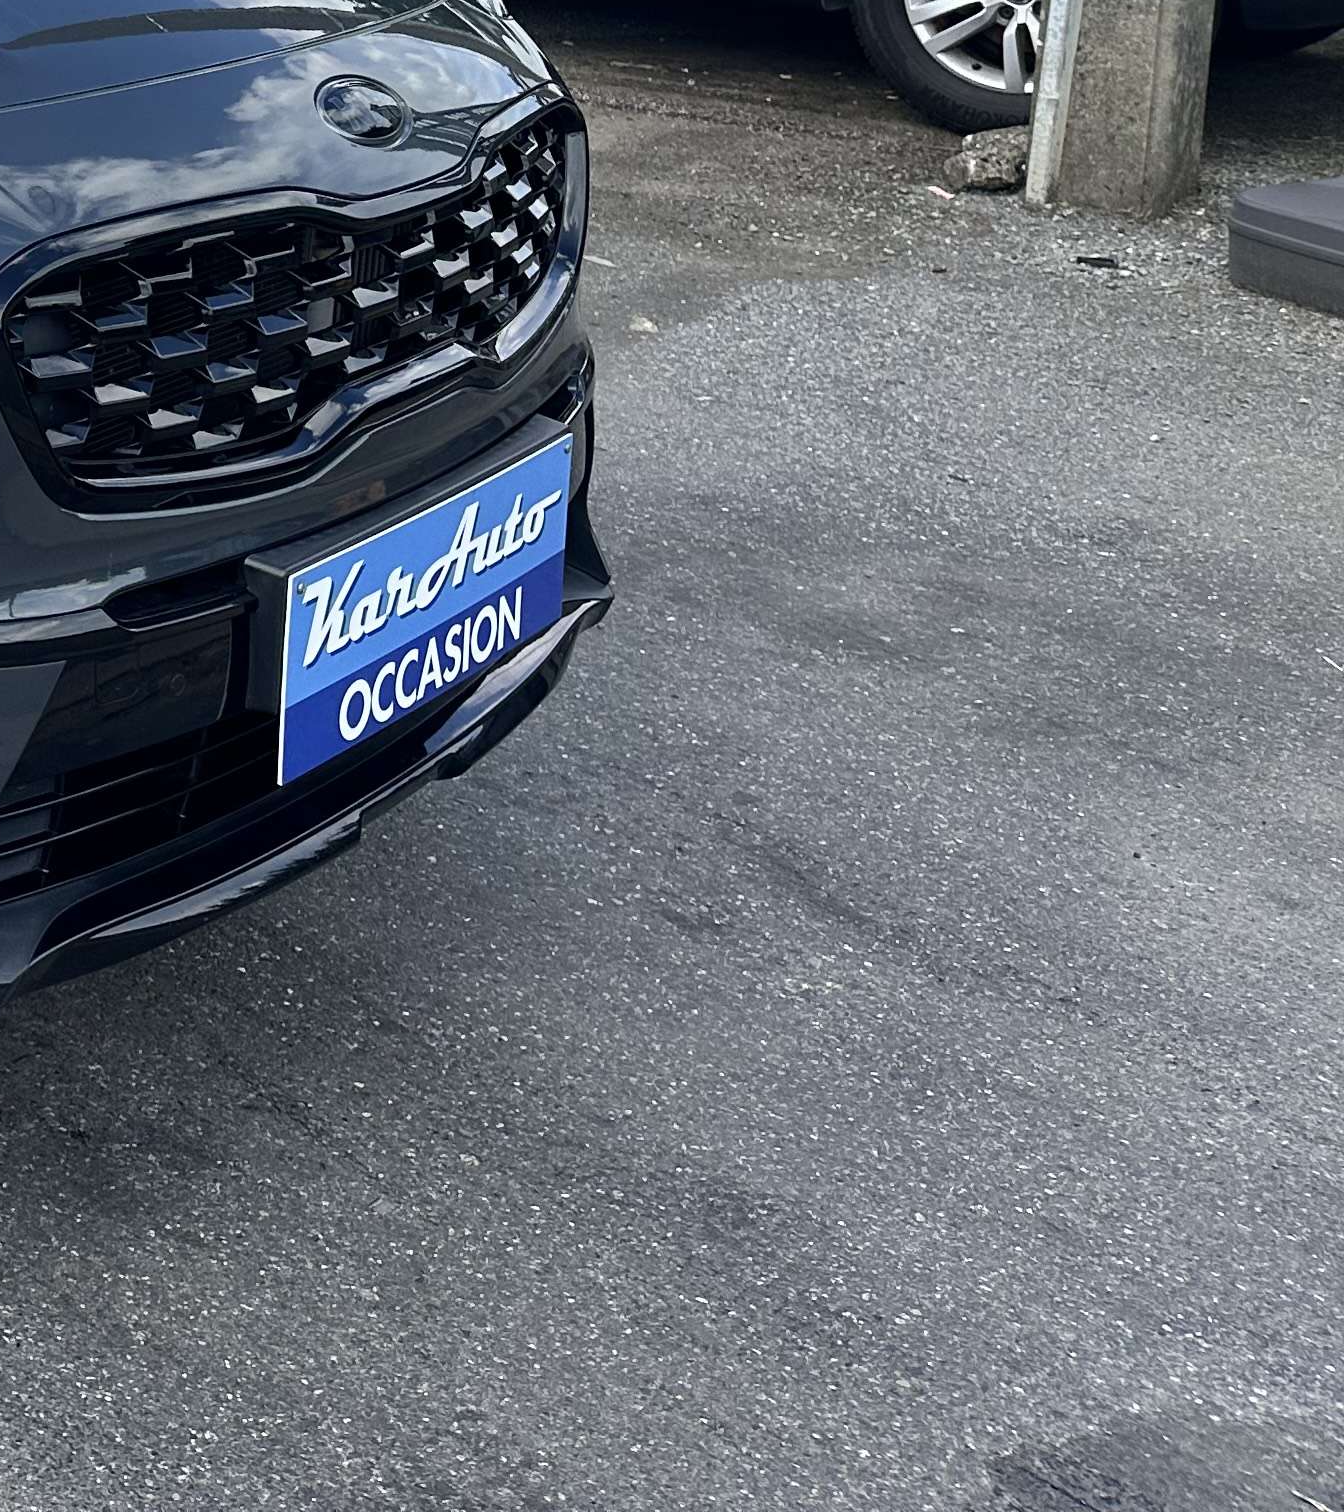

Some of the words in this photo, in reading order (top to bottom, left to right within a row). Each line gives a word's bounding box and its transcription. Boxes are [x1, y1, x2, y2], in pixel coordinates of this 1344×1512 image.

[302, 558, 415, 669] Kar
[413, 489, 563, 610] Auto
[338, 584, 523, 742] OCCASION
